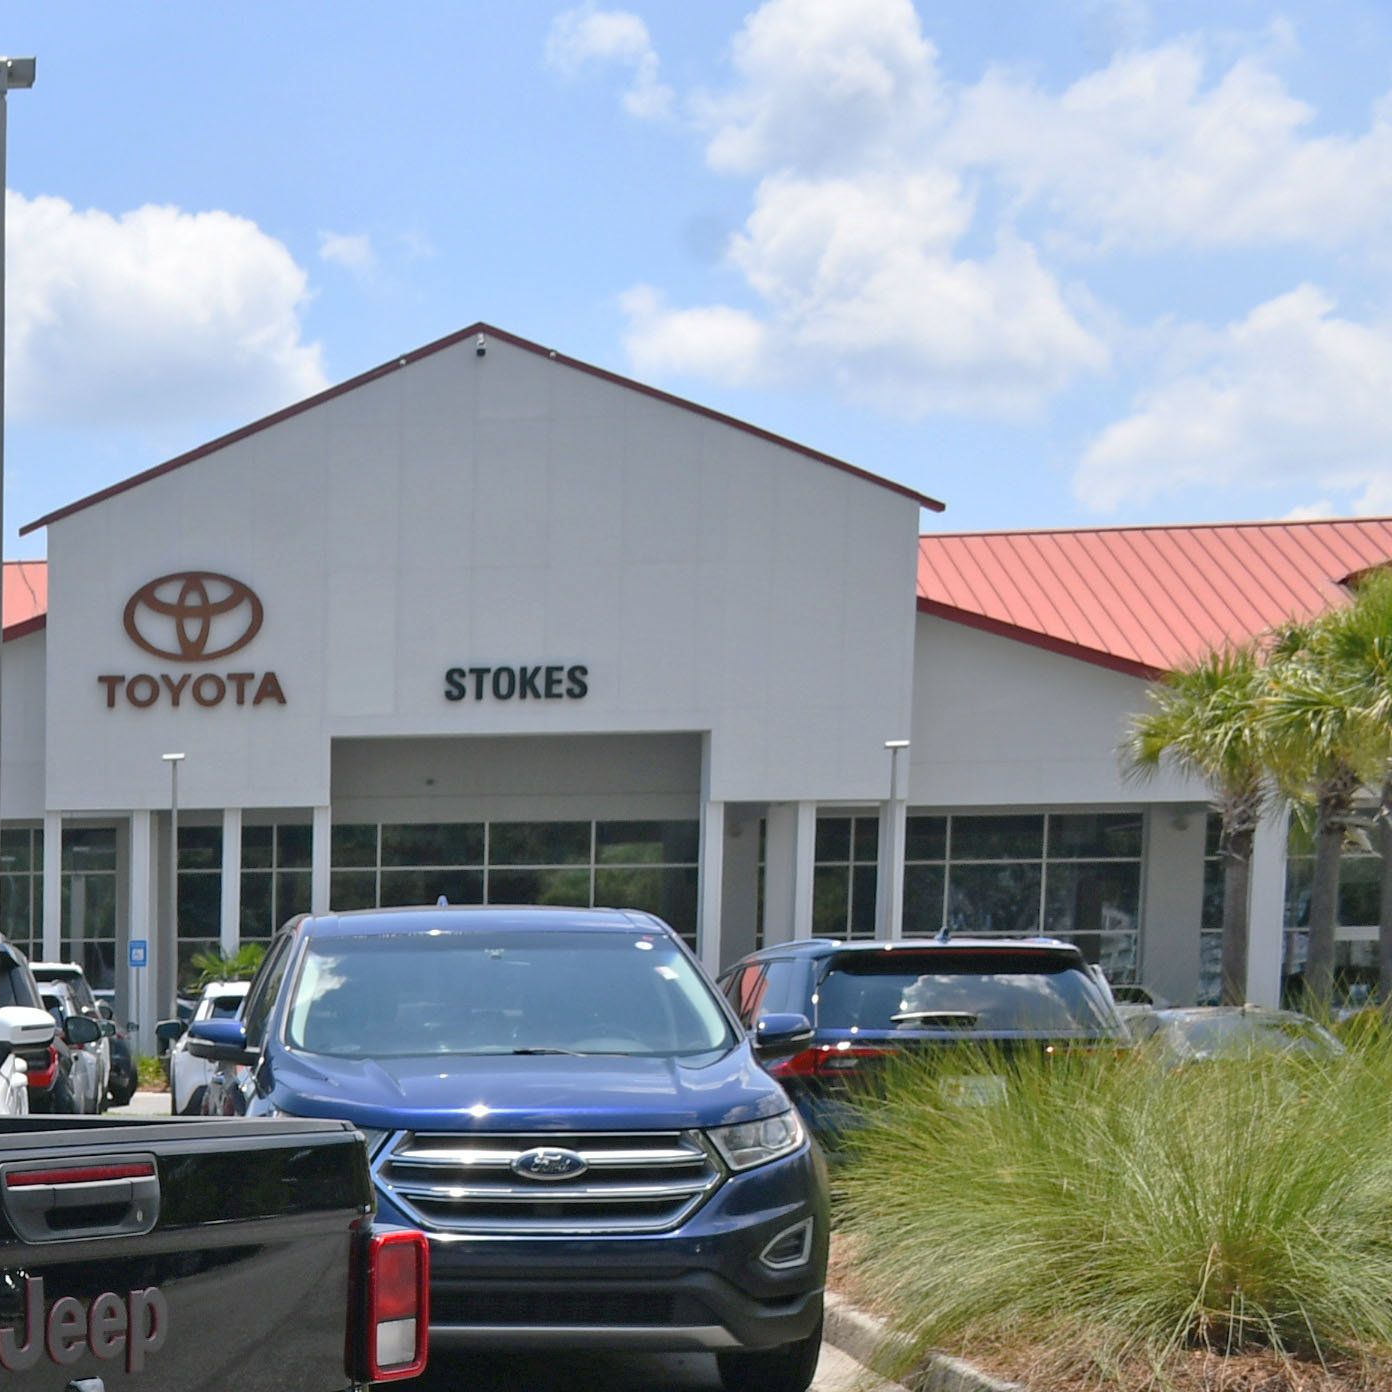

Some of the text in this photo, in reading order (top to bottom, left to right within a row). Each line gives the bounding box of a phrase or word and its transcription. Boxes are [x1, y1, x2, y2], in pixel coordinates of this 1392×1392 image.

[97, 671, 287, 708] TOYOTA
[444, 665, 588, 701] STOKES
[530, 1152, 571, 1172] Ford
